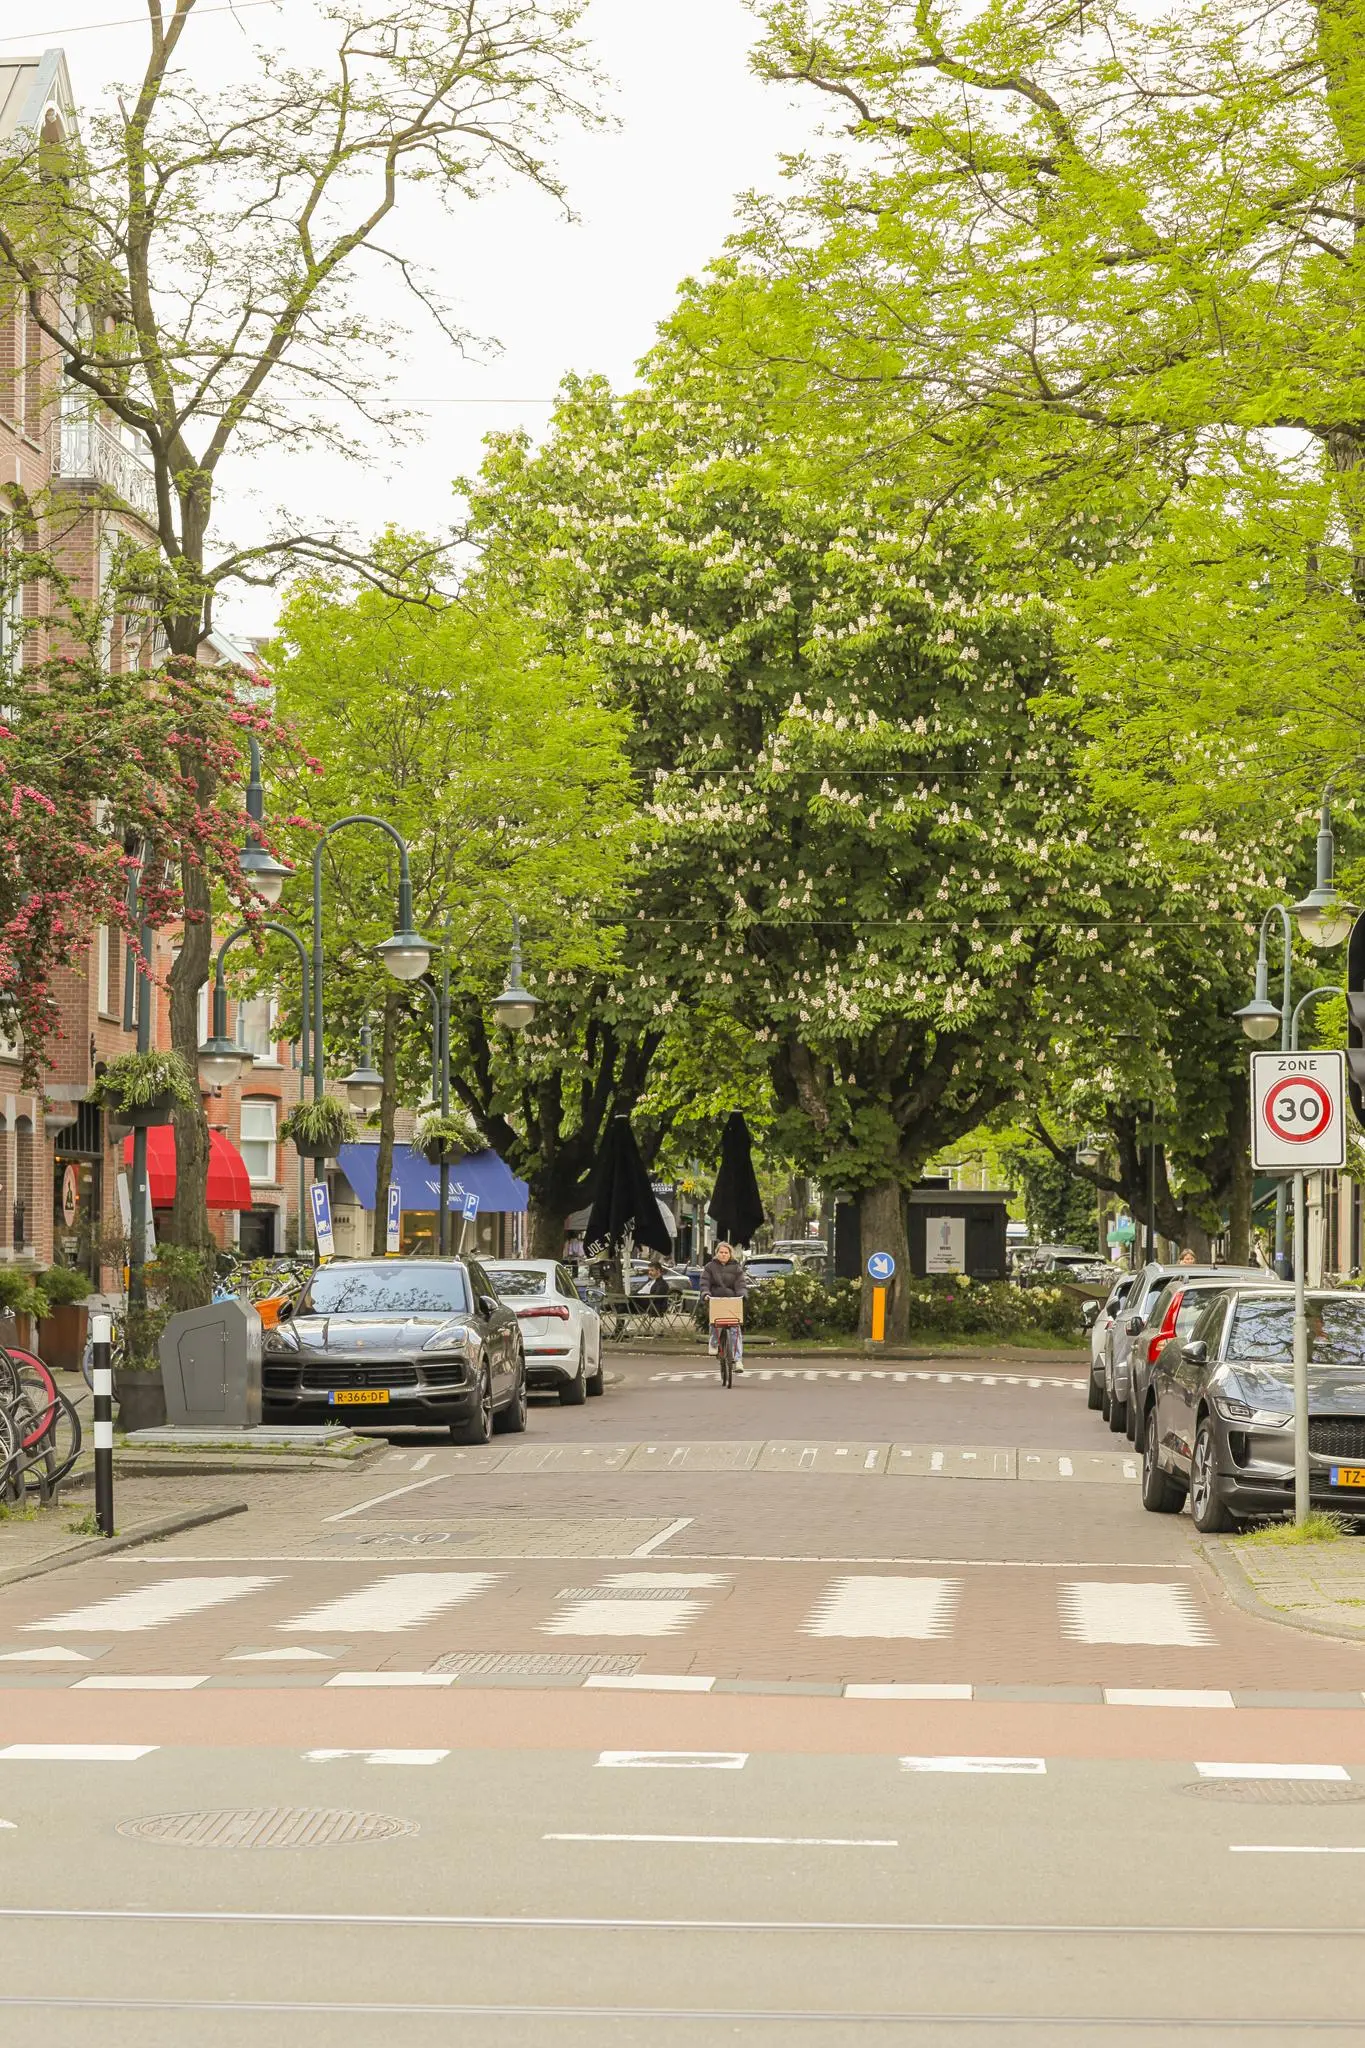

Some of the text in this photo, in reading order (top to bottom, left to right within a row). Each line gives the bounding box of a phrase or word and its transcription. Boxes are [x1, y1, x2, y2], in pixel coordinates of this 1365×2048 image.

[1278, 1060, 1317, 1071] ZONE
[1277, 1097, 1320, 1122] 30
[314, 1189, 325, 1216] P
[390, 1190, 398, 1215] P
[467, 1196, 476, 1209] P
[337, 1391, 385, 1402] R-366-DF
